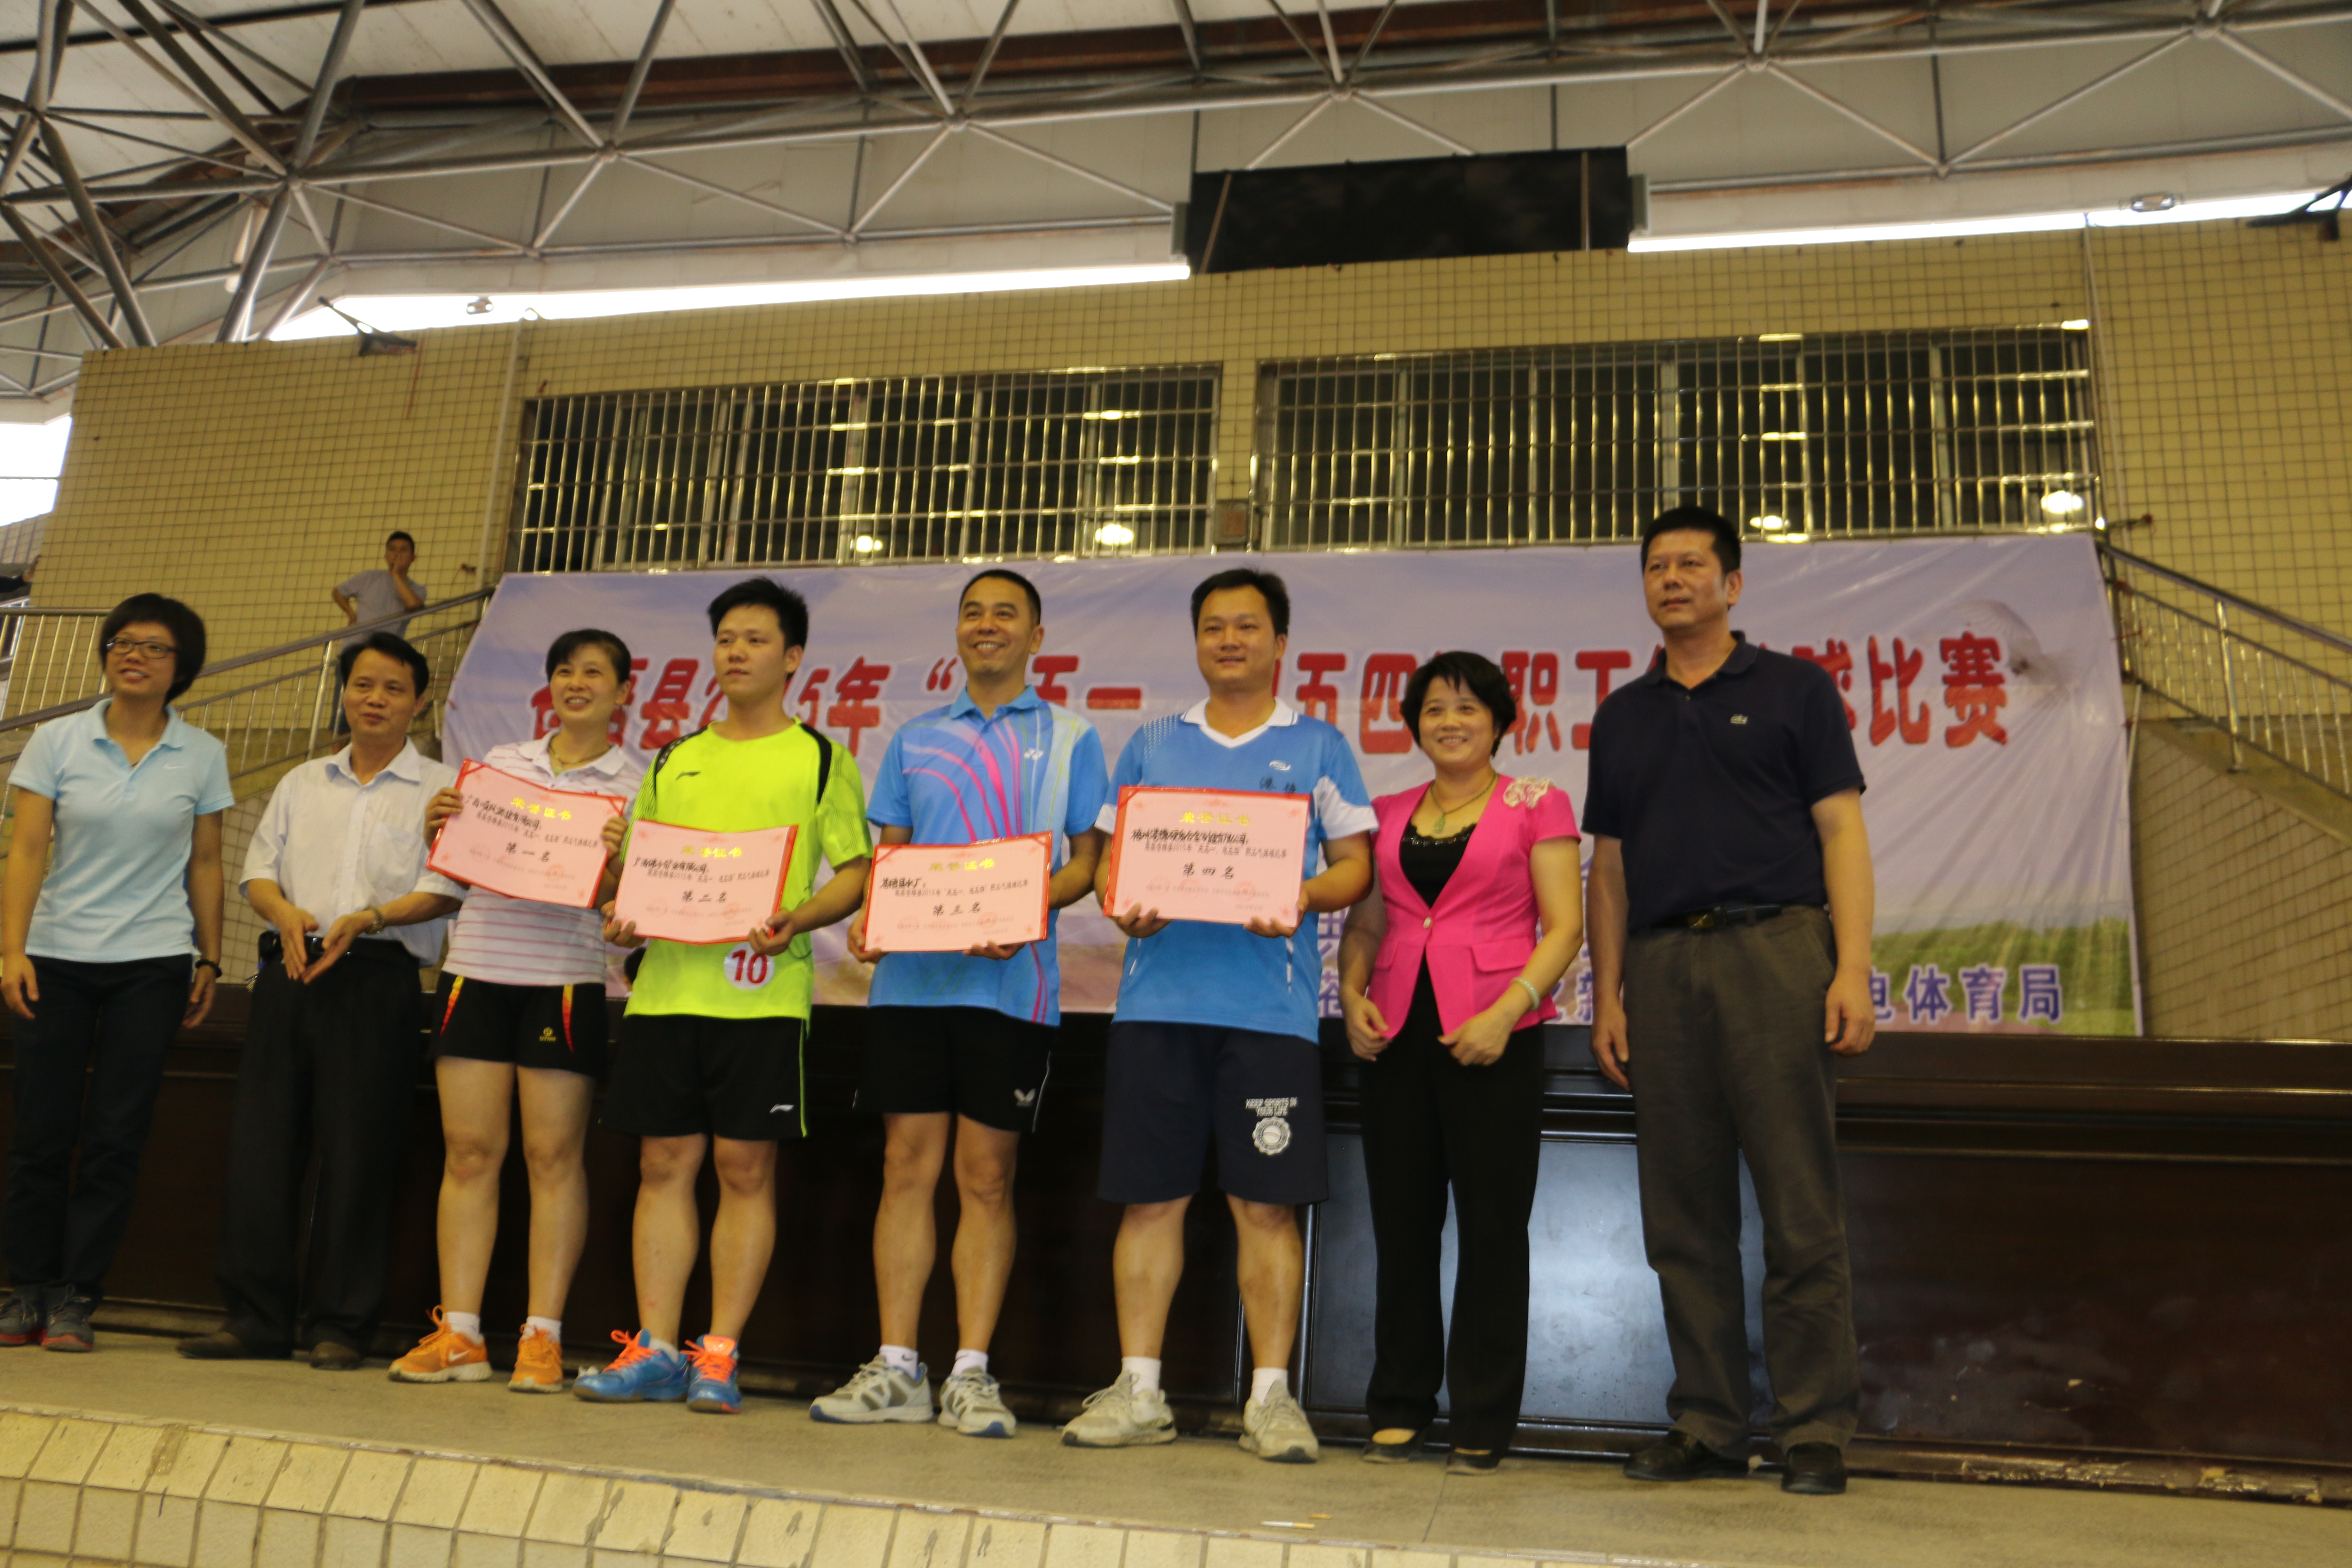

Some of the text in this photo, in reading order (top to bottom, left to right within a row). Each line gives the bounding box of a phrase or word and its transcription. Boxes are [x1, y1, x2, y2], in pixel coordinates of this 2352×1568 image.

[510, 797, 572, 821] 荣誉证书
[1180, 811, 1251, 825] 荣誉证书
[505, 841, 551, 863] 第一名
[929, 858, 995, 872] 荣誉证书
[1182, 861, 1235, 879] 第四名
[681, 890, 728, 903] 第二名
[932, 901, 982, 917] 第三名
[731, 949, 769, 984] 10
[1245, 1097, 1298, 1109] KEEP SPORTS IN
[1256, 1106, 1288, 1116] YOUR LIFE
